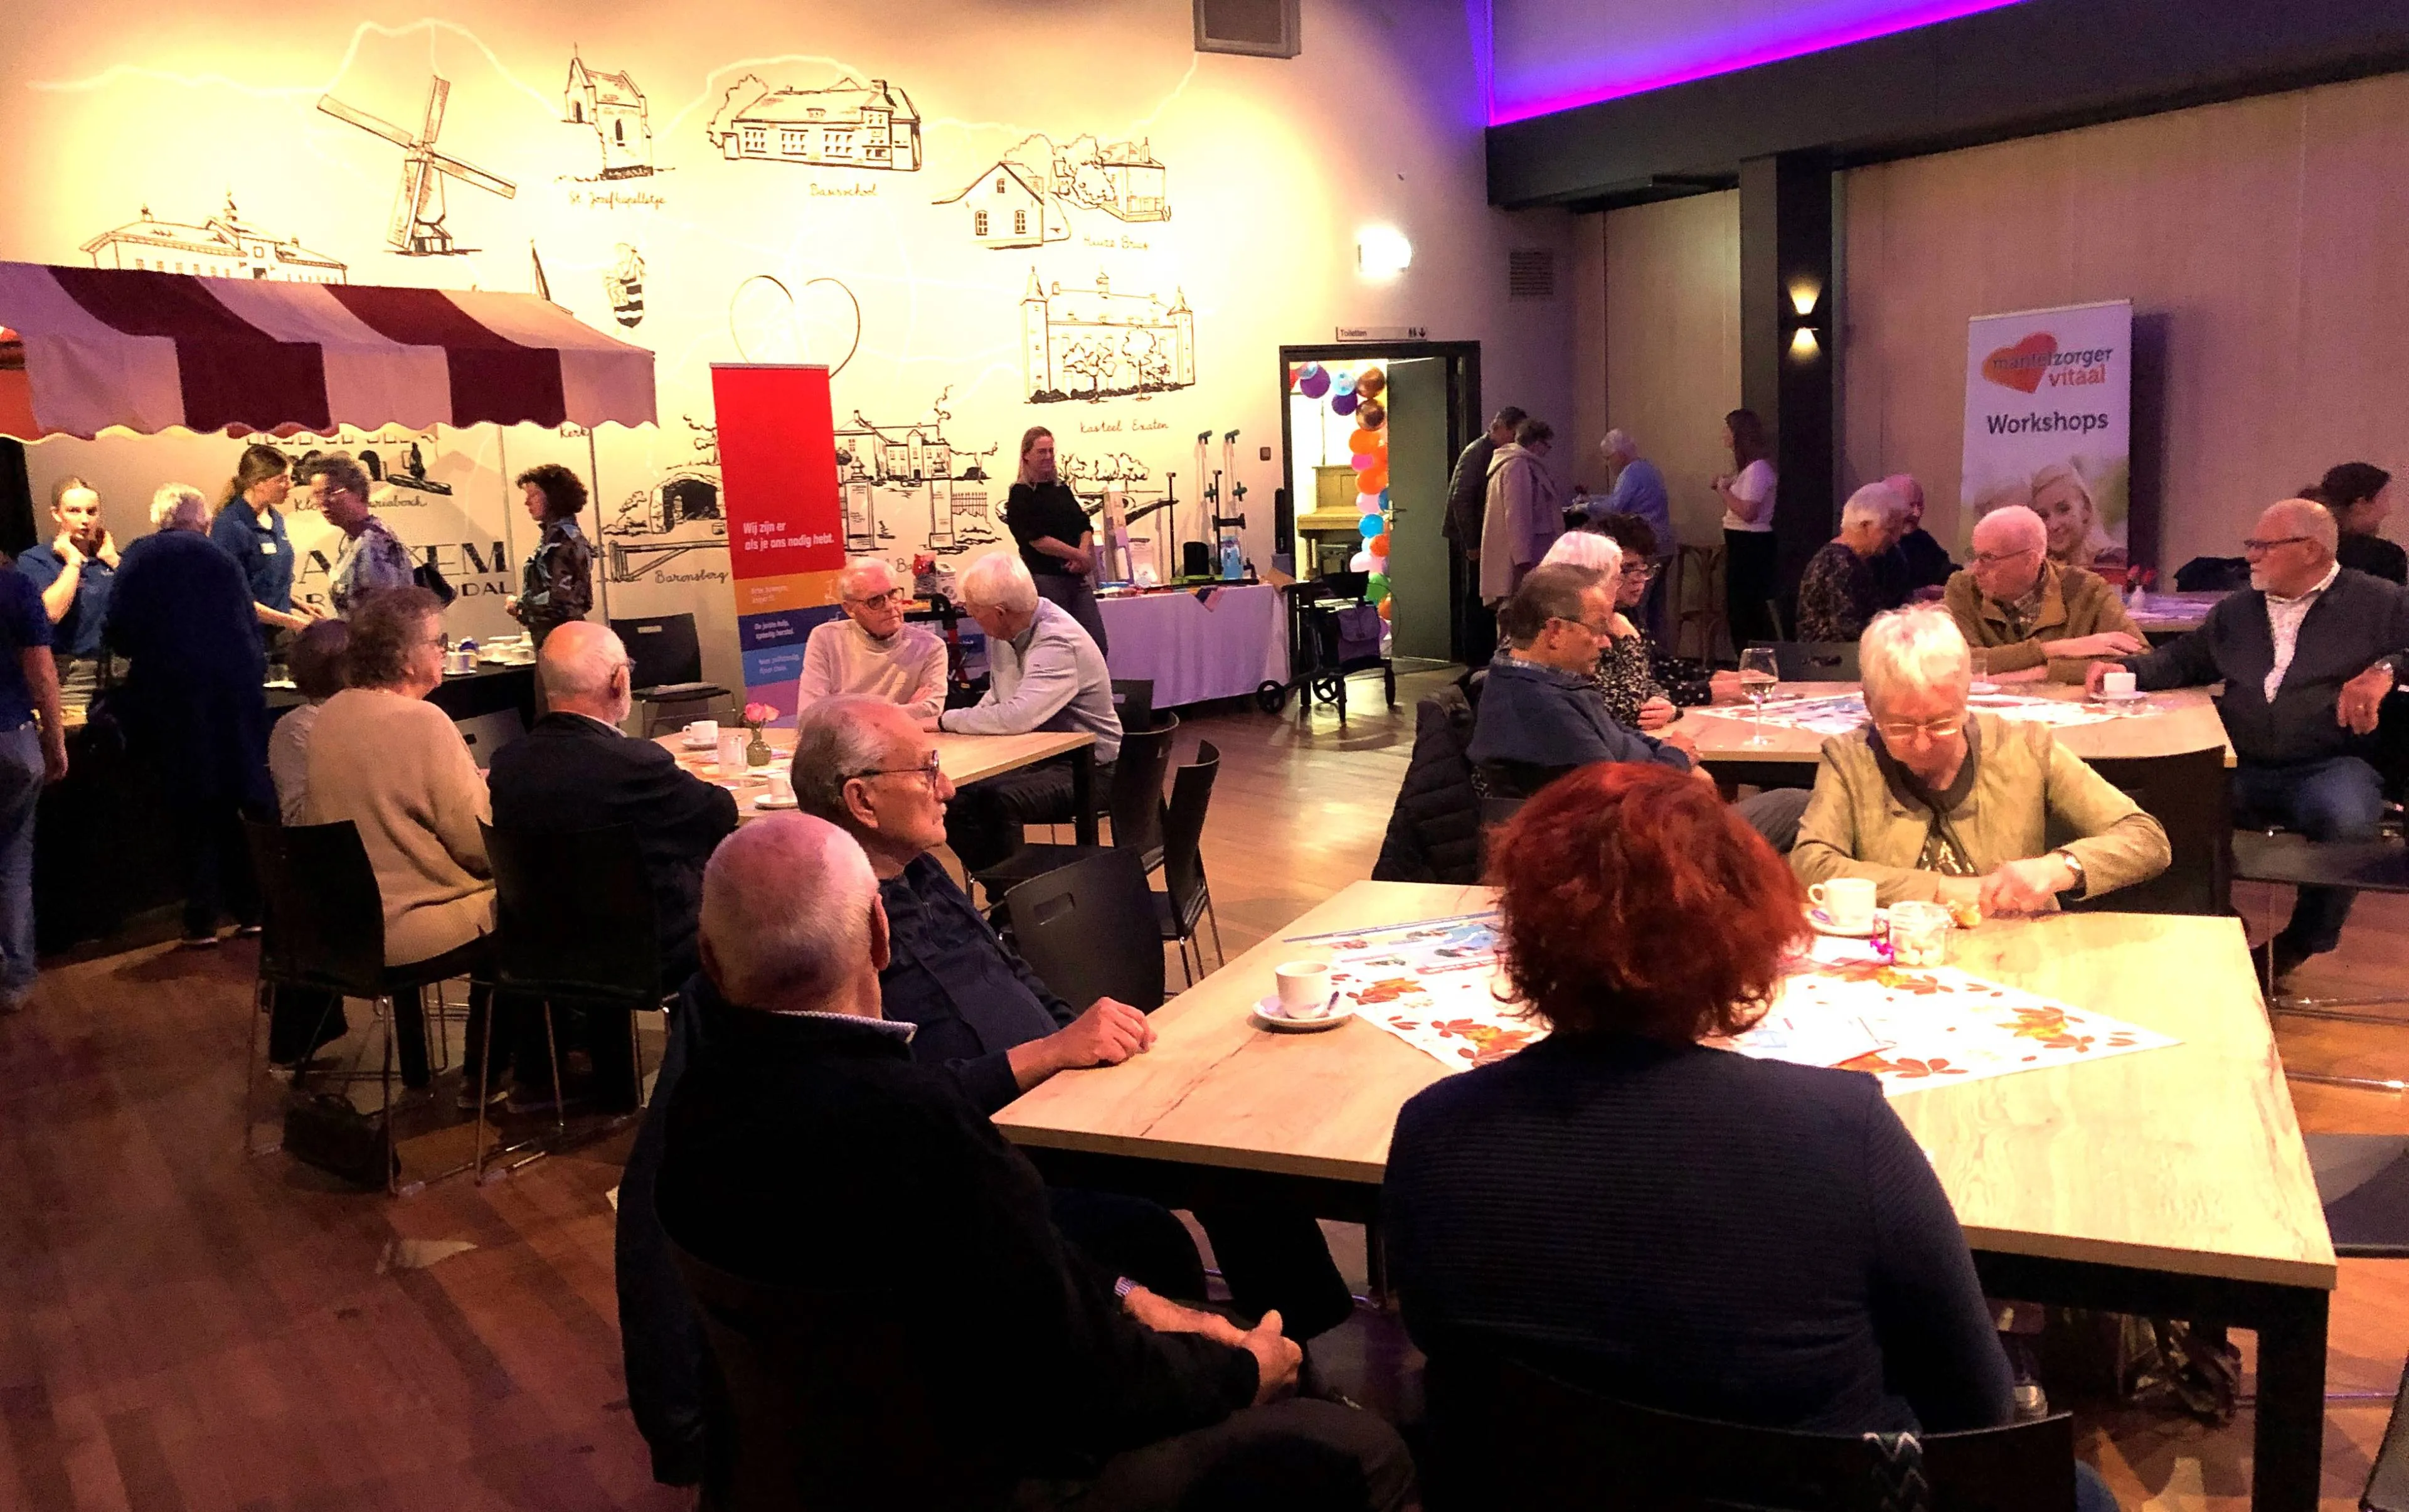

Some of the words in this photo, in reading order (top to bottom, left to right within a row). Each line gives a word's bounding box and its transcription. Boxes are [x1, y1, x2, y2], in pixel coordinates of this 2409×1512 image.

[1992, 348, 2114, 369] mantelzorger
[2048, 363, 2107, 387] vitaal
[1987, 411, 2109, 435] Workshops
[743, 521, 758, 536] Wij
[759, 521, 775, 535] zijn
[776, 522, 786, 531] er
[745, 538, 758, 551] als
[759, 537, 768, 551] je
[770, 538, 786, 548] ons
[787, 535, 812, 548] nodig
[813, 532, 835, 545] hebt.
[655, 569, 729, 584] Baronsberg
